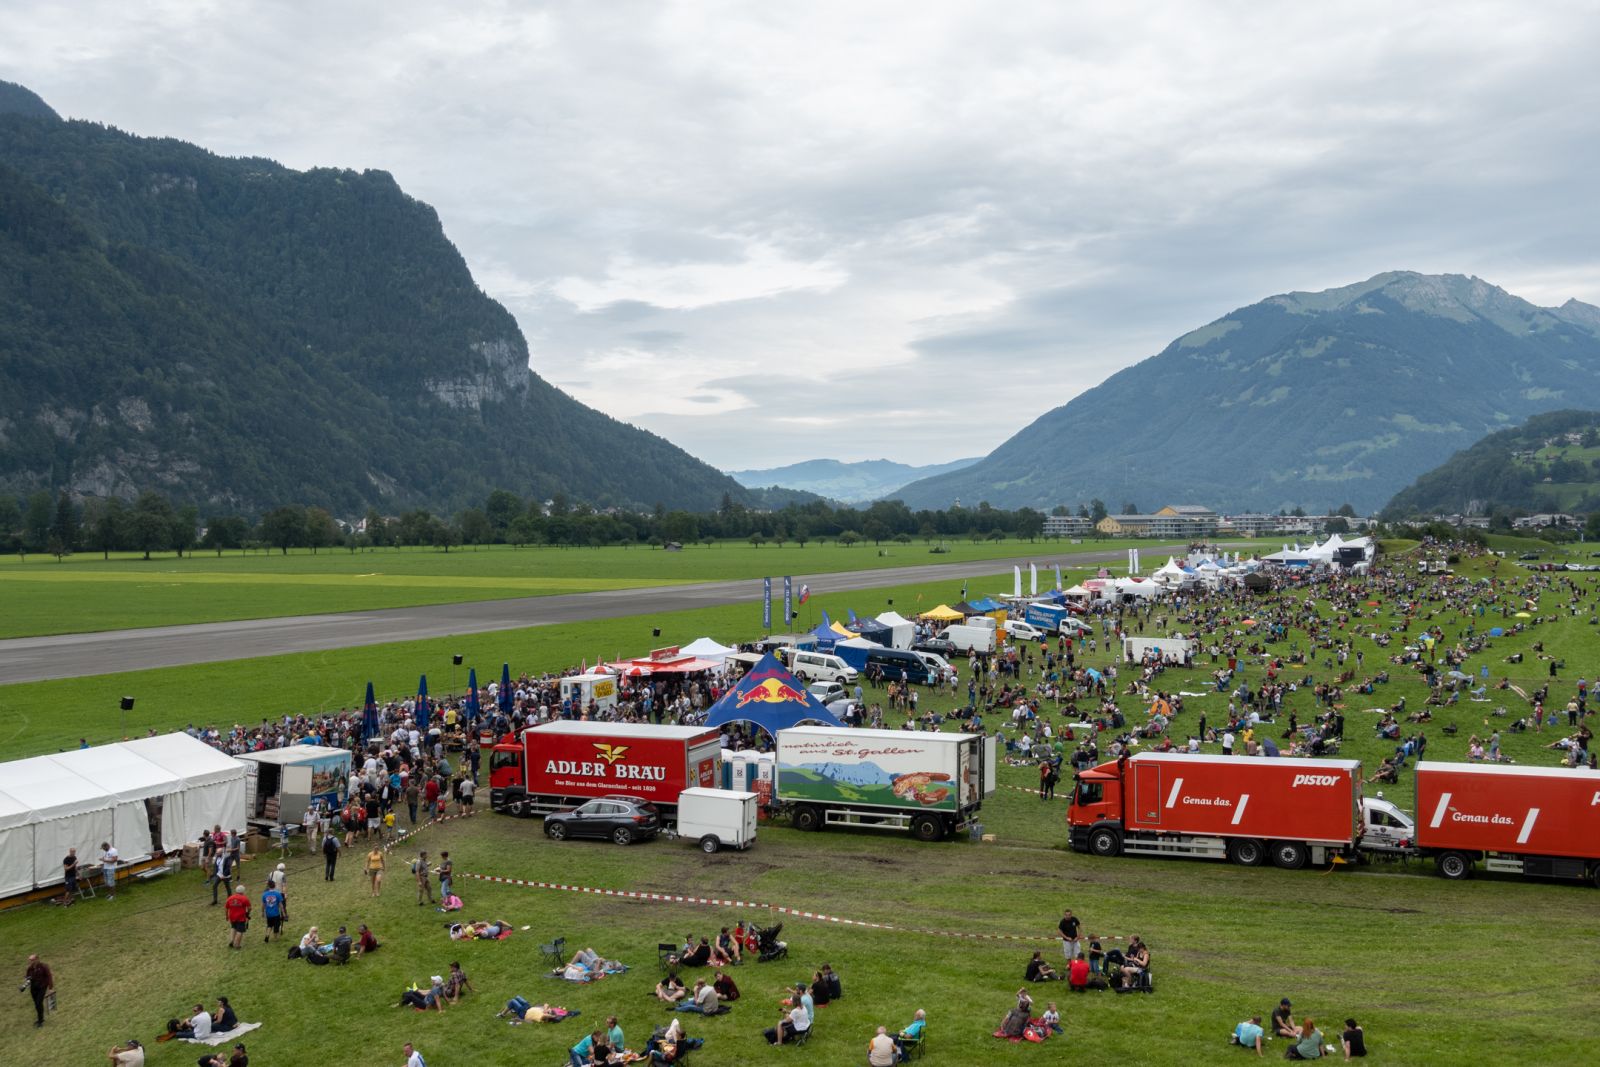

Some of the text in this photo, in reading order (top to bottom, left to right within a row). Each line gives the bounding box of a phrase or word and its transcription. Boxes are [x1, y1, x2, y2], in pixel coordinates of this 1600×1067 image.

[545, 760, 666, 780] ADLER BRÄU
[1183, 795, 1232, 806] Genau das.
[1452, 811, 1515, 825] Genau das.
